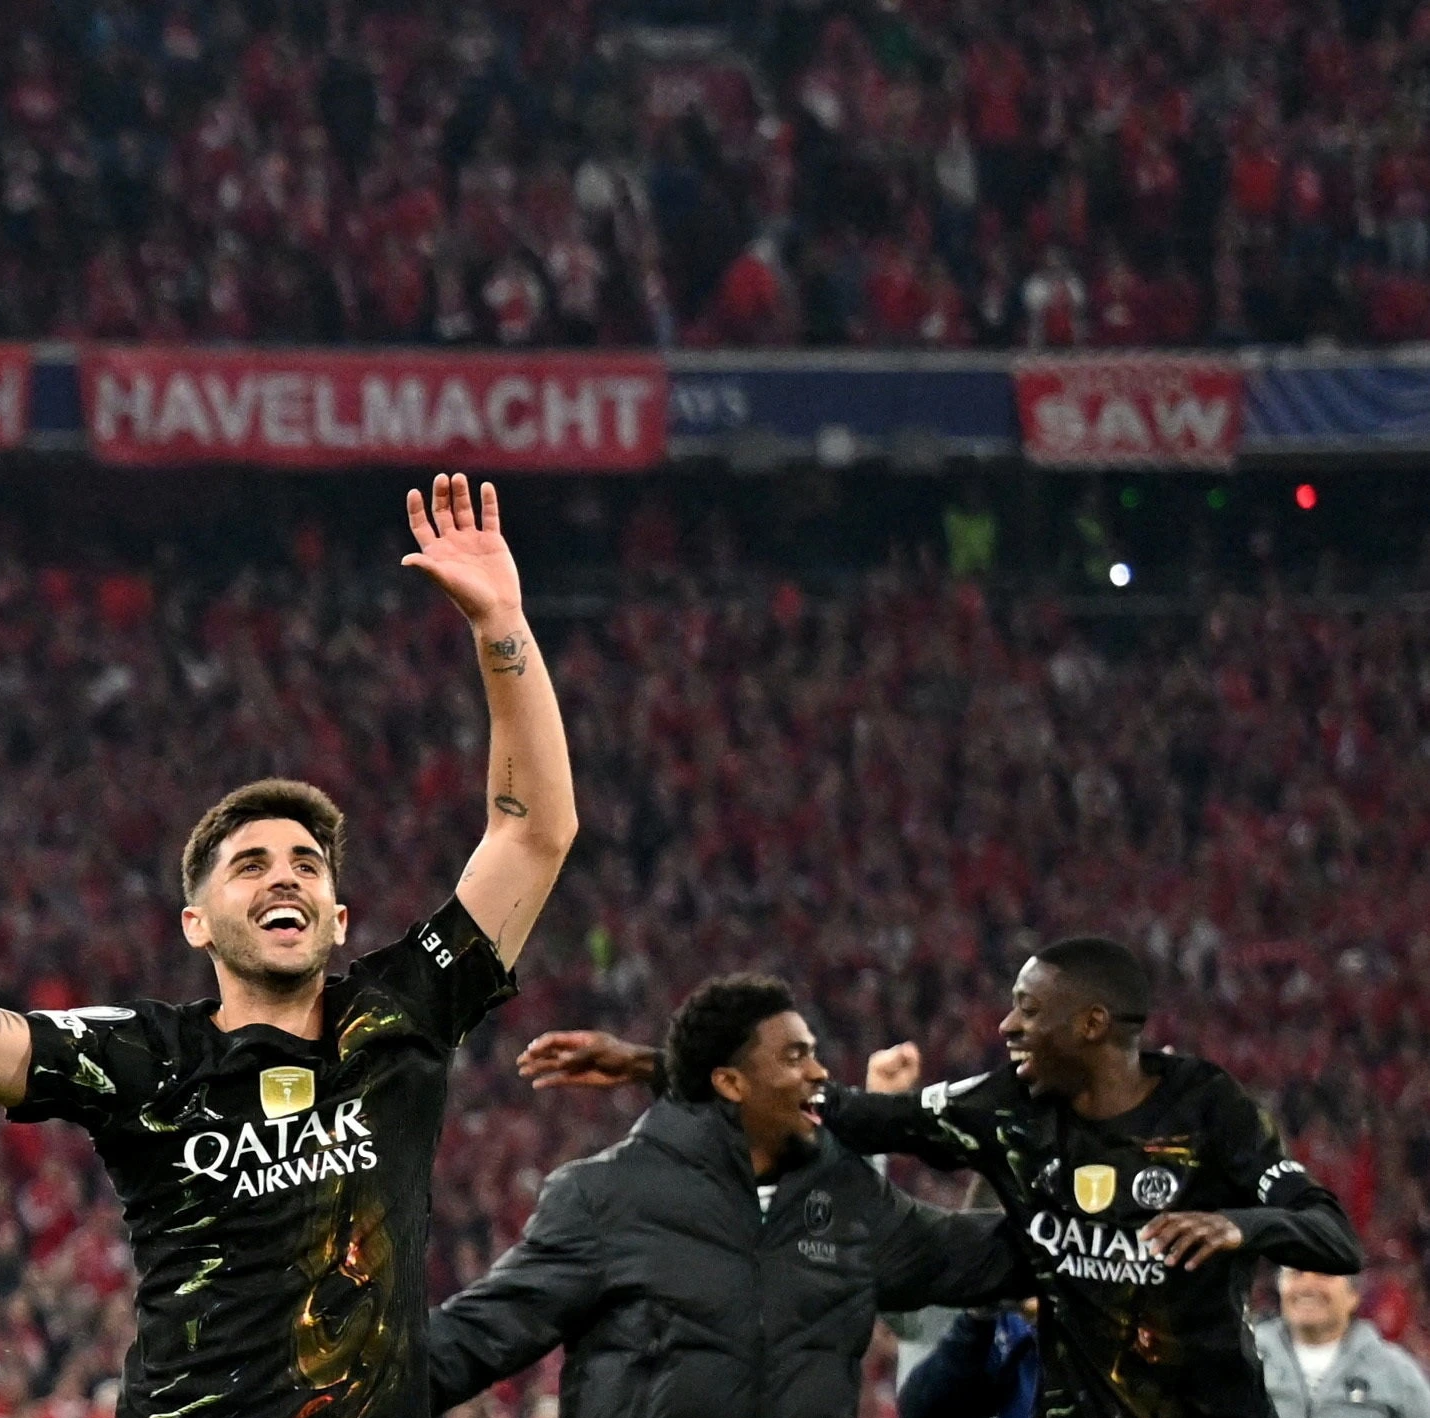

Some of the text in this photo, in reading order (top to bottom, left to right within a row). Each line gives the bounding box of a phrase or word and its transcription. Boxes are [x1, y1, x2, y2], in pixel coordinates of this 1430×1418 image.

[95, 371, 654, 451] HAVELMACHT
[1032, 398, 1230, 447] SAW
[183, 1098, 373, 1182] QATAR
[232, 1140, 378, 1199] AIRWAYS
[1055, 1252, 1167, 1286] AIRWAYS
